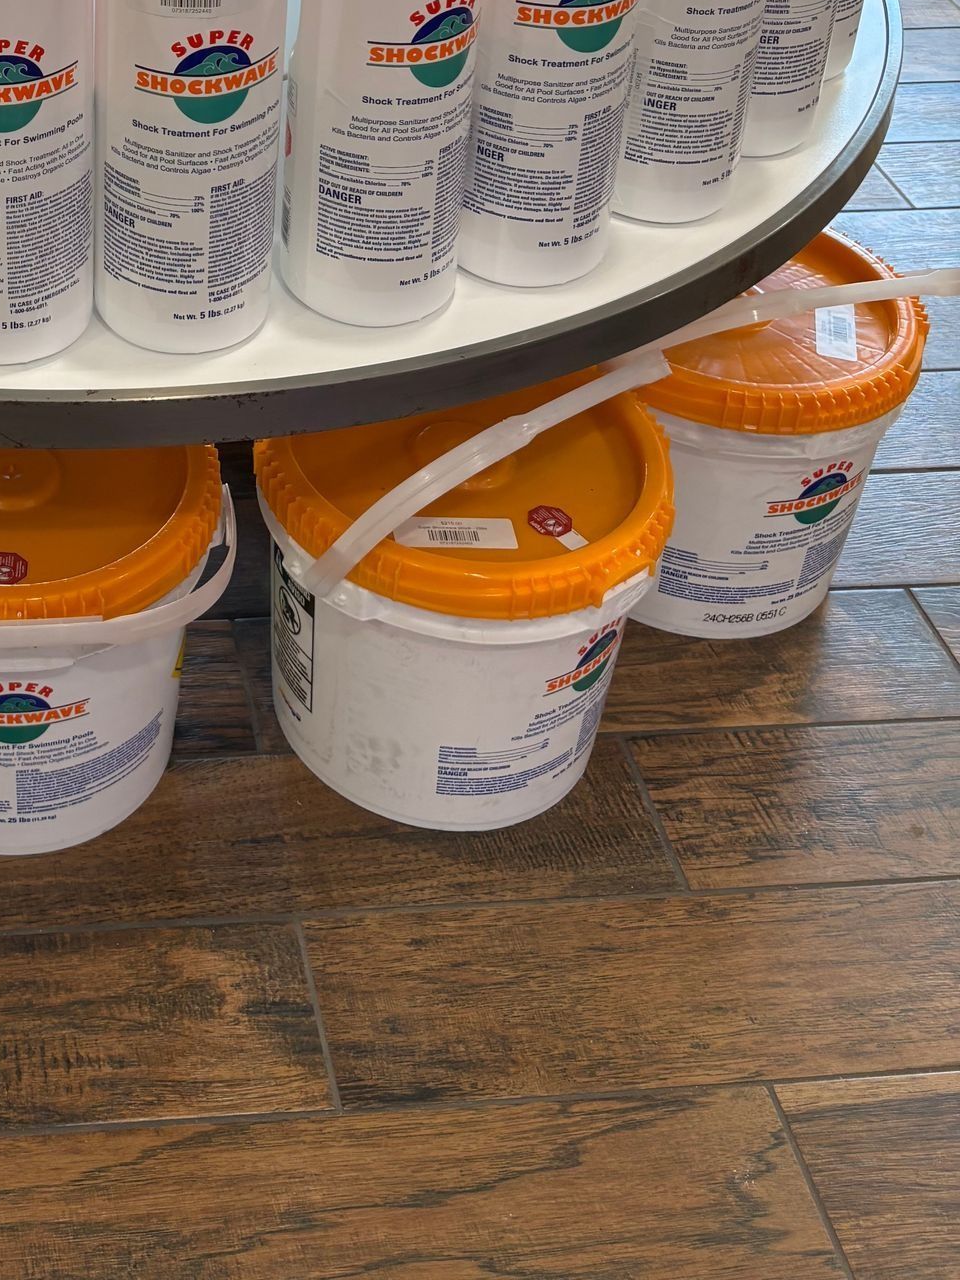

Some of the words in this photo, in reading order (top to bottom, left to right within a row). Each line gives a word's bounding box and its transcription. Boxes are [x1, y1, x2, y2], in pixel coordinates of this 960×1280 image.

[686, 7, 715, 16] Shock
[171, 30, 254, 58] SUPER
[508, 54, 538, 66] Shock
[541, 57, 589, 68] Treatment
[591, 55, 604, 65] For
[136, 57, 276, 95] SHOCKWAVE
[362, 95, 392, 106] Shock
[396, 94, 442, 106] Treatment
[444, 88, 455, 99] For
[4, 138, 20, 146] For
[23, 124, 65, 143] Swimming
[67, 113, 84, 128] Pools
[132, 119, 159, 134] Shock
[161, 127, 210, 138] Treatment
[213, 127, 227, 136] For
[230, 111, 266, 132] Swimming
[476, 145, 504, 162] NGER
[210, 182, 231, 194] FIRST
[319, 184, 362, 205] DANGER
[5, 194, 27, 204] FIRST
[104, 201, 135, 229] DANGER
[423, 272, 428, 281] 5
[200, 311, 206, 319] 5
[1, 321, 7, 330] 5
[10, 321, 26, 329] lbs.
[800, 460, 853, 487] SUPER
[779, 525, 811, 537] Treatment
[661, 569, 688, 580] DANGER
[779, 606, 787, 616] C
[28, 737, 70, 749] Swimming
[72, 730, 94, 740] Pools
